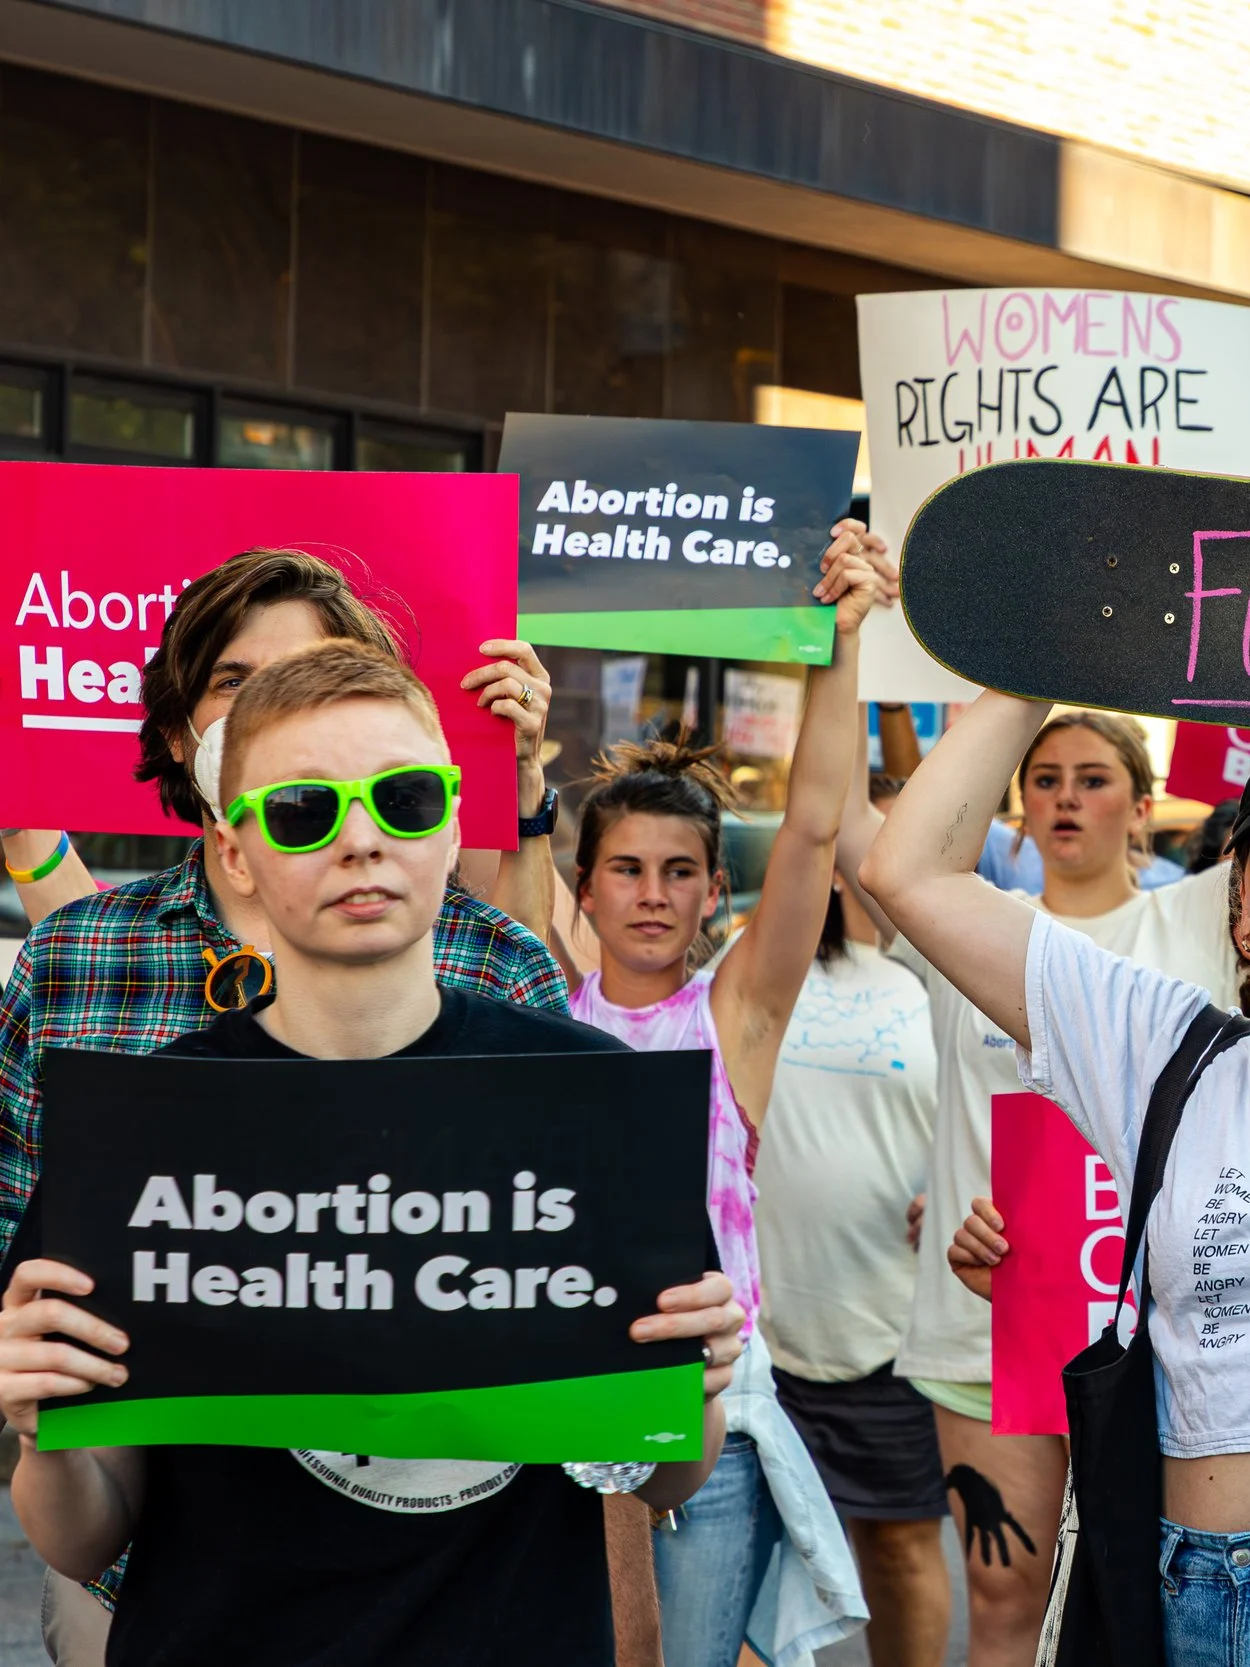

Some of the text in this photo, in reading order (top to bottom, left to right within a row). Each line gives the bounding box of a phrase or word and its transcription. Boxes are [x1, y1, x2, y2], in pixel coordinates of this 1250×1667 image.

[942, 291, 1182, 366] WOMENS
[895, 365, 1215, 449] RIGHTS ARE
[537, 479, 776, 523] Abortion is
[531, 523, 792, 569] Health Care.
[19, 645, 161, 705] Hea
[1219, 1166, 1244, 1178] LET
[127, 1170, 577, 1235] Abortion is
[1205, 1197, 1224, 1209] BE
[1198, 1212, 1246, 1224] ANGRY
[1193, 1228, 1219, 1240] LET
[1192, 1243, 1248, 1257] WOMEN
[1194, 1262, 1210, 1274] BE
[132, 1250, 619, 1313] Health Care.
[1195, 1276, 1244, 1291] ANGRY
[1198, 1293, 1221, 1303] LET
[1201, 1322, 1218, 1334] BE
[1200, 1333, 1244, 1348] ANGRY
[351, 1484, 394, 1507] QUALITY
[395, 1494, 453, 1509] PRODUCTS
[459, 1474, 503, 1501] PROUDLY
